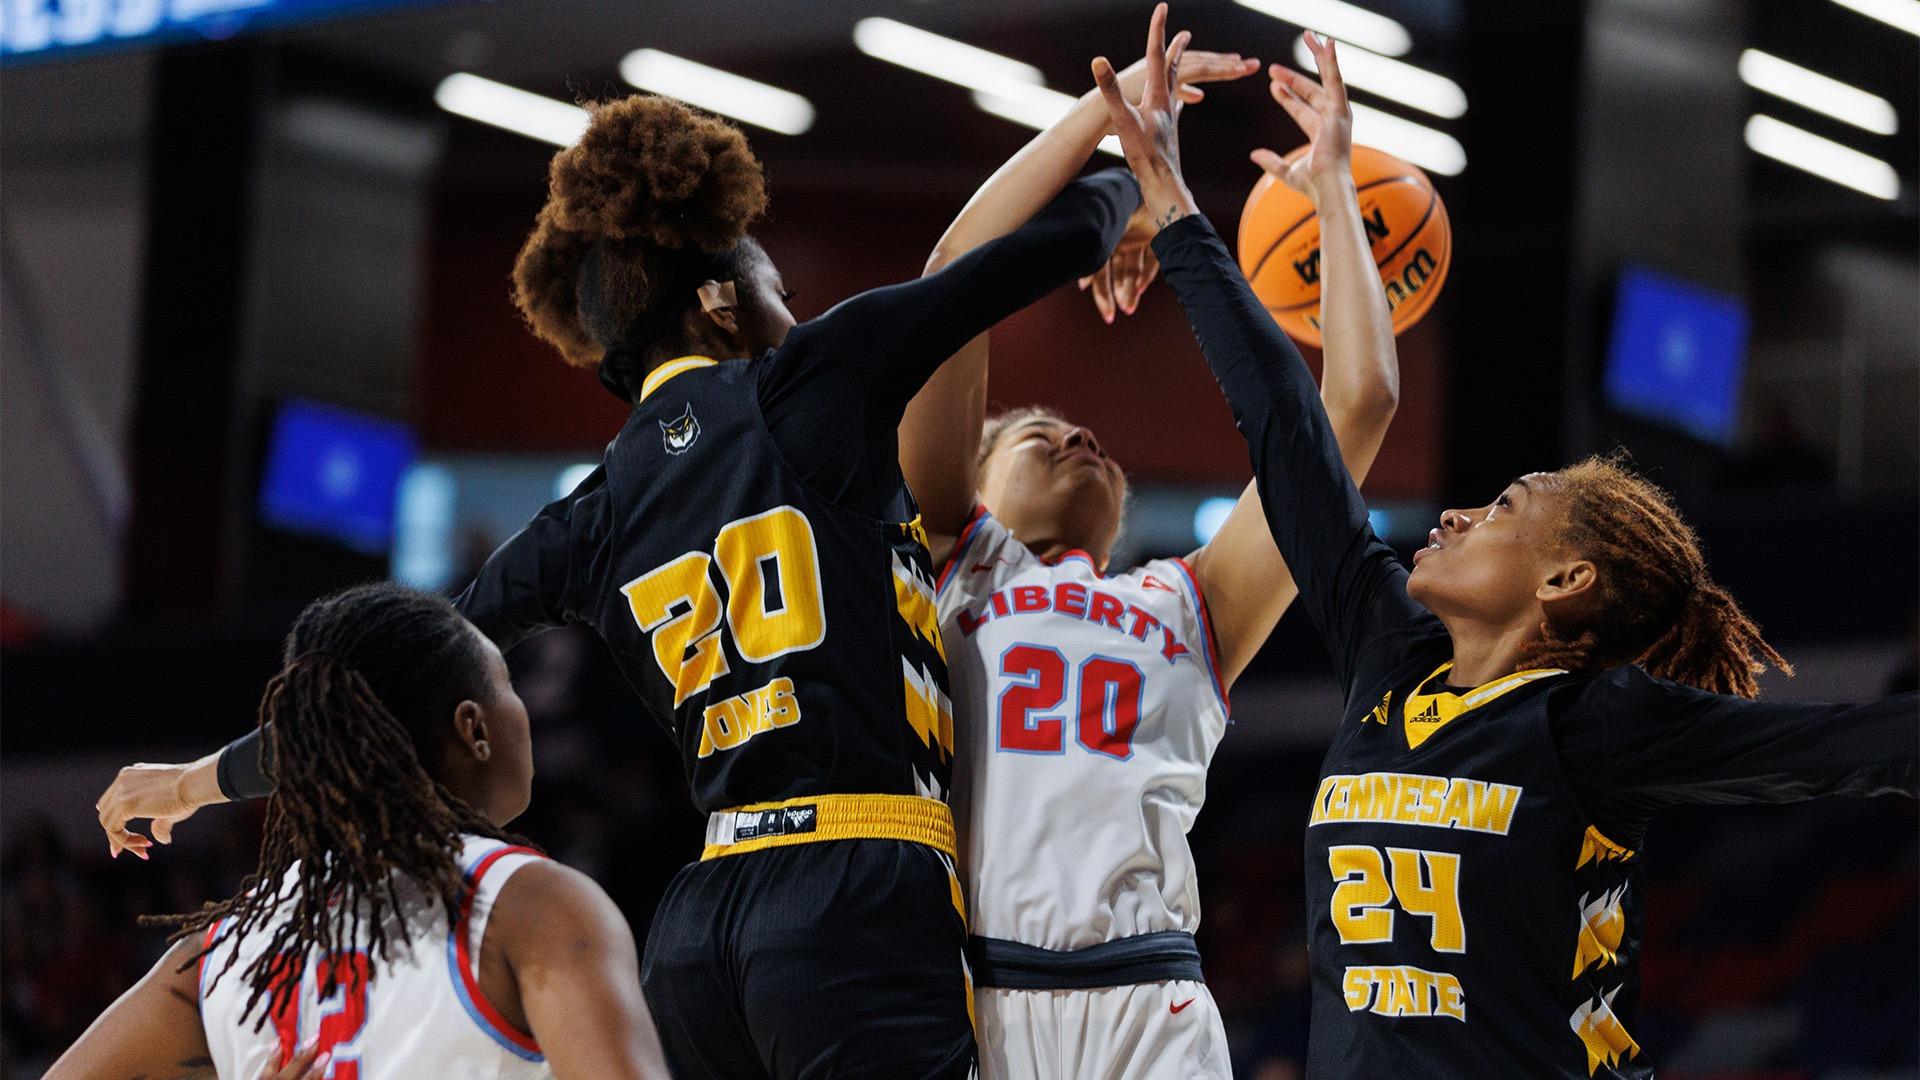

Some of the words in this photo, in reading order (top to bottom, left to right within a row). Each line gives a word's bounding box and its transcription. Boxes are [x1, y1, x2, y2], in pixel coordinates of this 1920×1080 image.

[1293, 207, 1390, 287] NA
[619, 505, 826, 710] 20
[956, 582, 1192, 665] LIBERTY
[996, 641, 1146, 763] 20
[1309, 772, 1523, 835] KENNESAW
[1328, 845, 1466, 954] 24
[1343, 965, 1466, 1023] STATE
